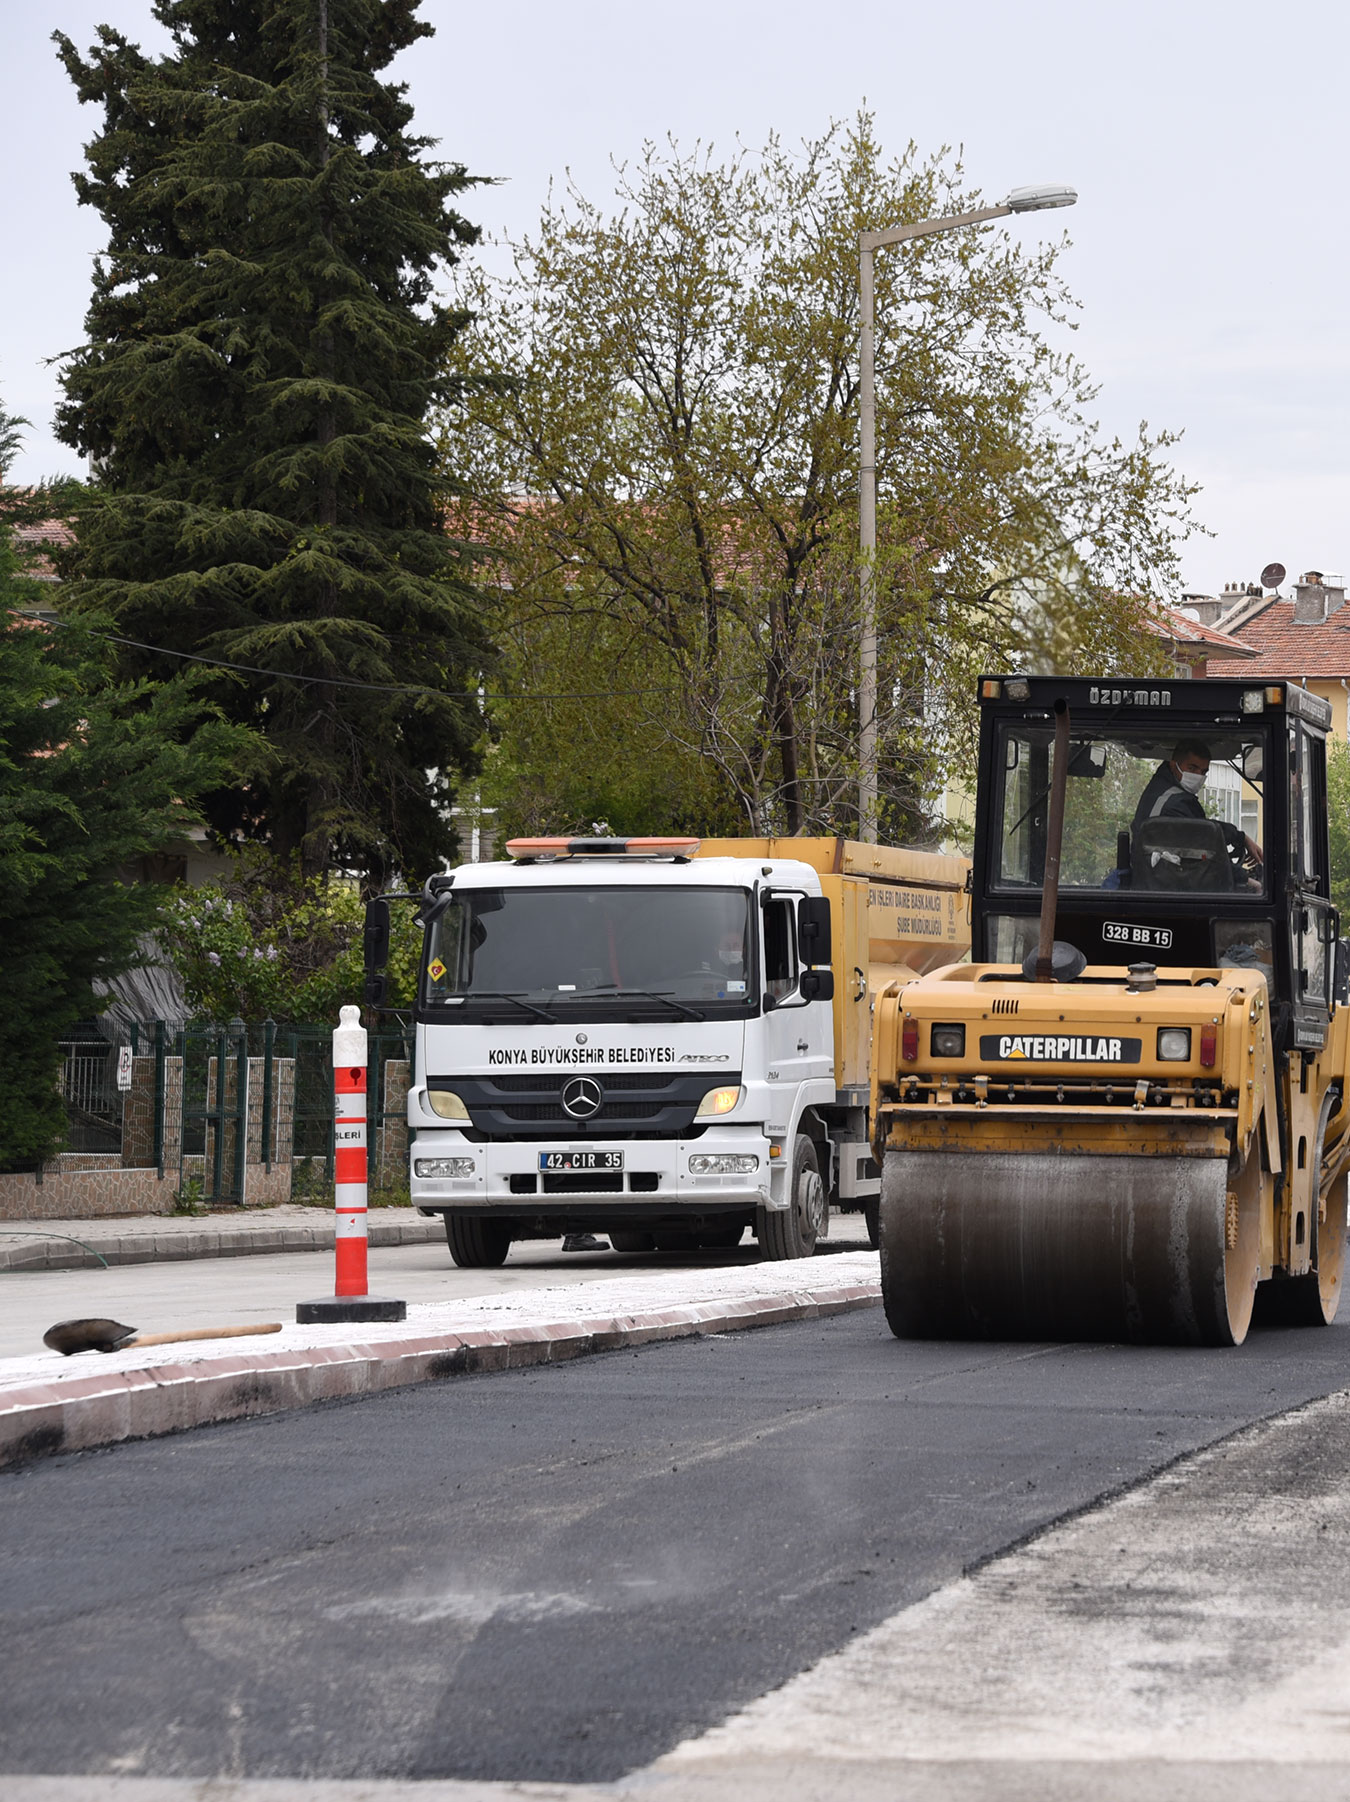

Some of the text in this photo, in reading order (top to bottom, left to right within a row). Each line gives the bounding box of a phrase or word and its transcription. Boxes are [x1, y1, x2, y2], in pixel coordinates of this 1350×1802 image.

[1106, 925, 1169, 945] 328 BB 15
[488, 1049, 528, 1064] KONYA
[999, 1036, 1122, 1061] CATERPILLAR
[546, 1153, 621, 1168] 42 CIR 35
